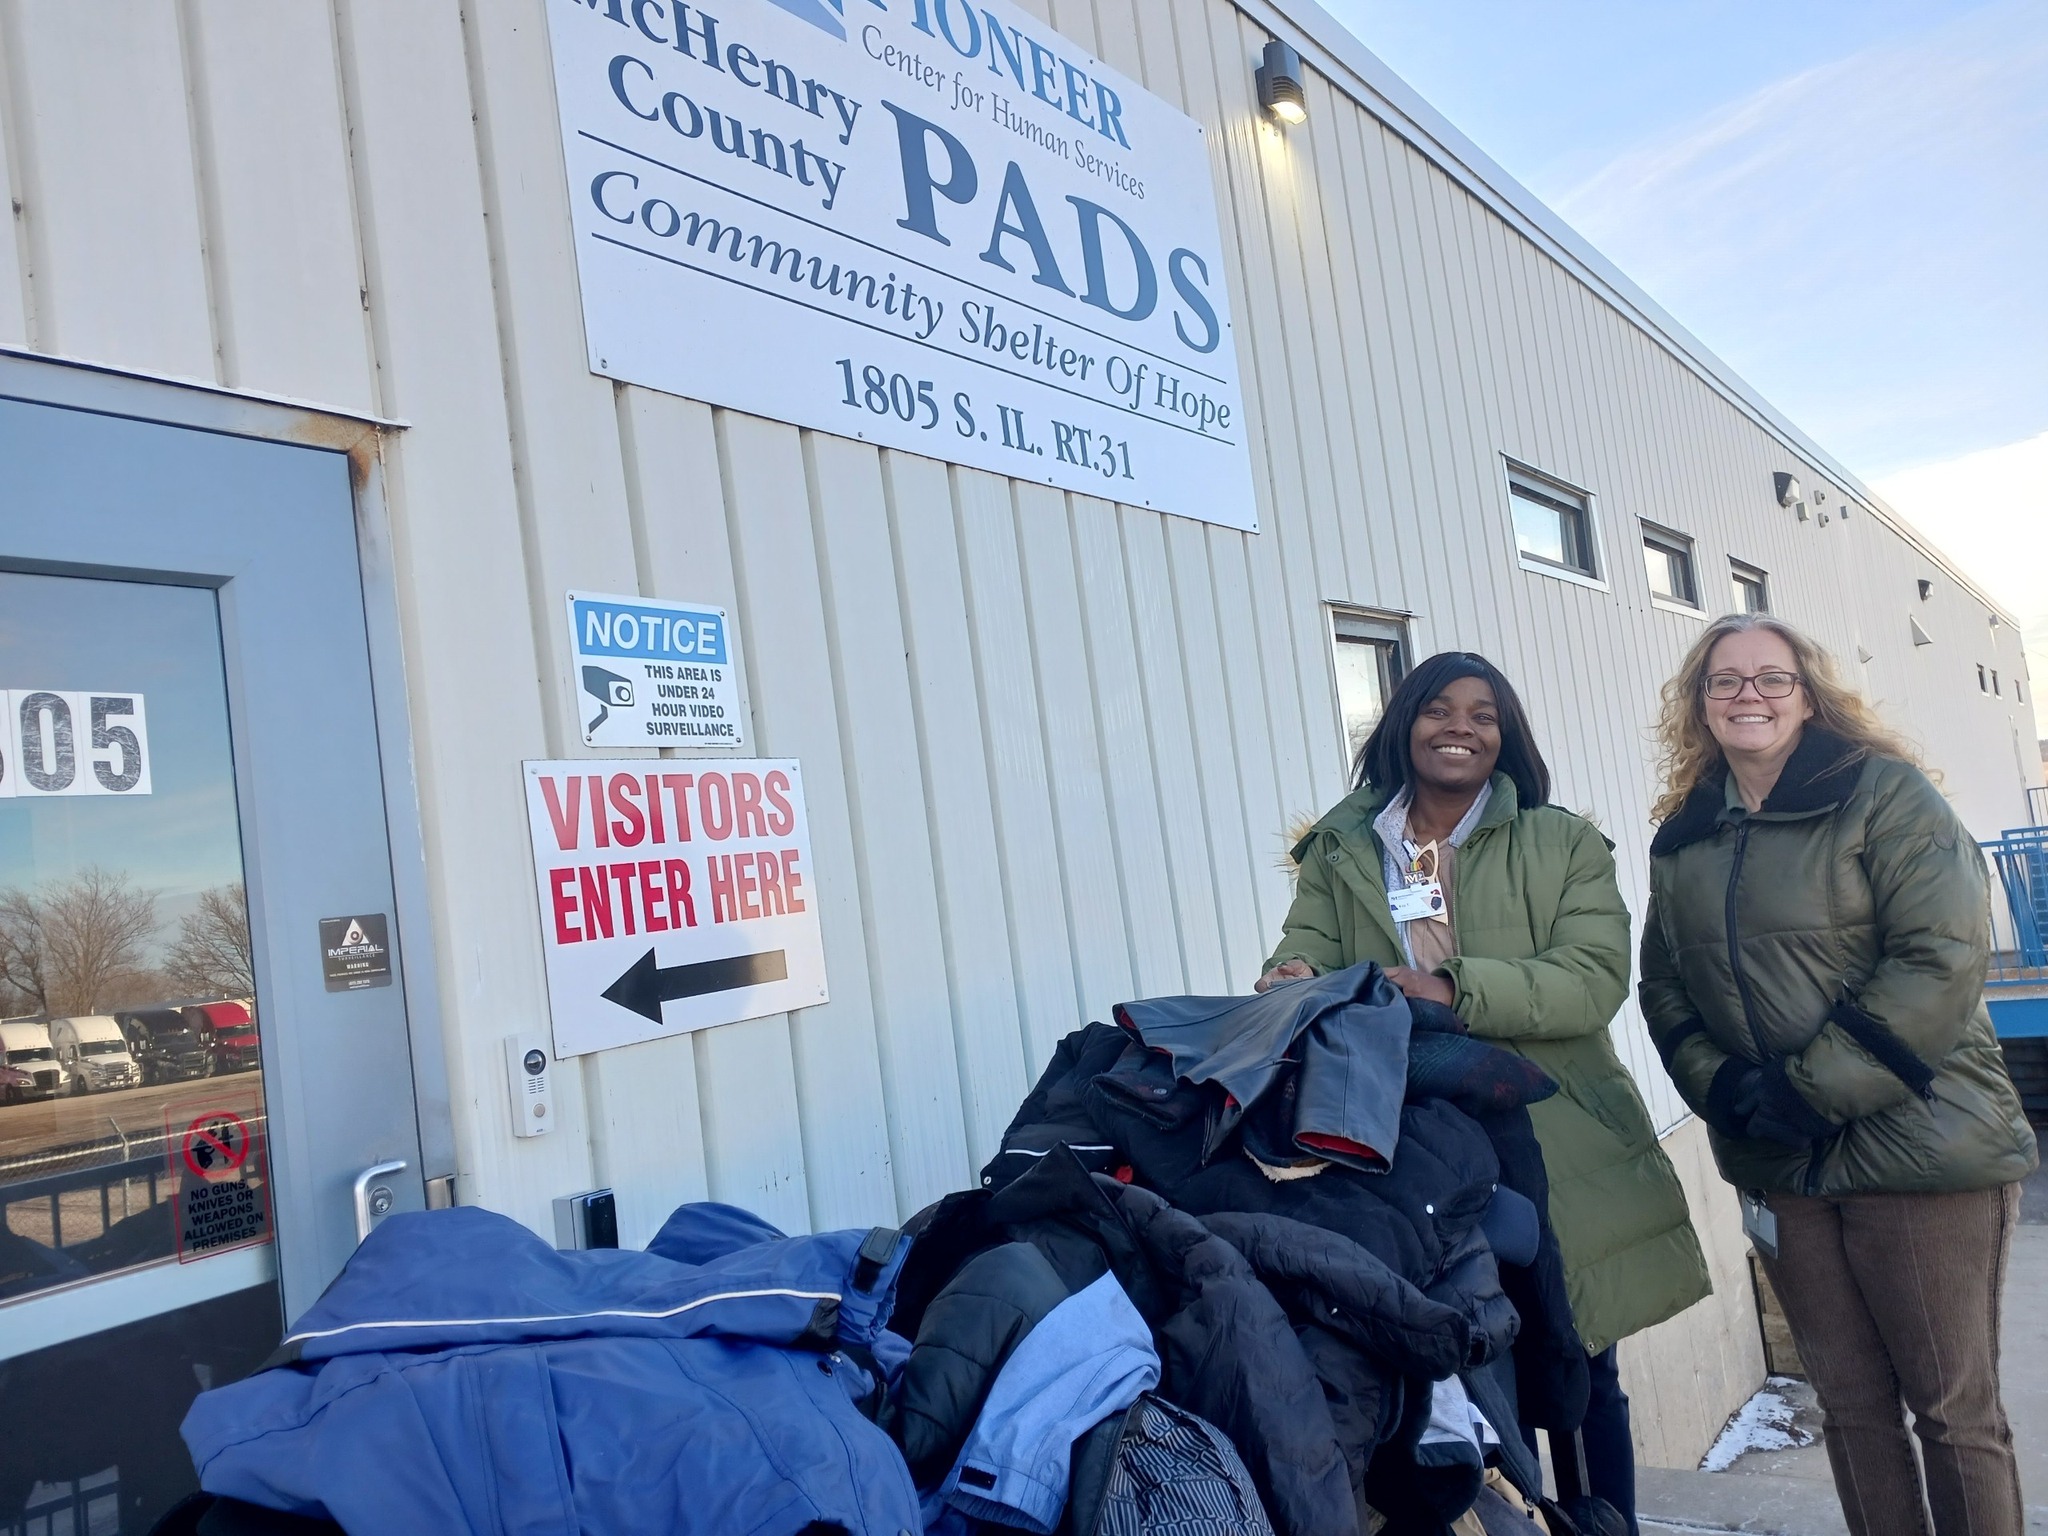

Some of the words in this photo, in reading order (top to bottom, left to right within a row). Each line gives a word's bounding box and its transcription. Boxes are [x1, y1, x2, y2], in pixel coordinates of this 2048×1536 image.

[867, 0, 1131, 151] ONEER
[862, 24, 945, 92] Center
[951, 72, 984, 113] for
[992, 92, 1069, 160] Human
[1074, 139, 1146, 200] Services
[608, 54, 846, 210] County
[880, 99, 1220, 354] PADS
[590, 171, 944, 340] Community
[959, 301, 1095, 381] Shelter
[1106, 355, 1148, 410] Of
[1154, 371, 1231, 432] Hope
[835, 359, 939, 430] 1805
[953, 392, 988, 442] S.
[996, 403, 1043, 456] IL.
[1050, 419, 1135, 480] RT.31
[586, 610, 717, 655] NOTICE
[644, 664, 674, 680] THIS
[677, 667, 708, 682] AREA
[711, 669, 722, 682] IS
[657, 684, 698, 699] UNDER
[701, 687, 715, 700] 24
[646, 722, 734, 737] SURVEILLANCE
[652, 703, 687, 717] HOUR
[689, 704, 724, 719] VIDEO
[0, 692, 141, 792] 05
[538, 770, 795, 851] VISITORS
[549, 859, 698, 945] ENTER
[707, 849, 806, 924] HERE
[327, 944, 384, 957] IMPERIAL
[188, 1195, 233, 1214] KNIVES
[236, 1190, 253, 1202] OR
[191, 1188, 208, 1201] NO
[184, 1218, 243, 1241] ALLOWED
[246, 1212, 263, 1225] ON
[192, 1202, 253, 1226] WEAPONS
[192, 1227, 256, 1252] PREMISES
